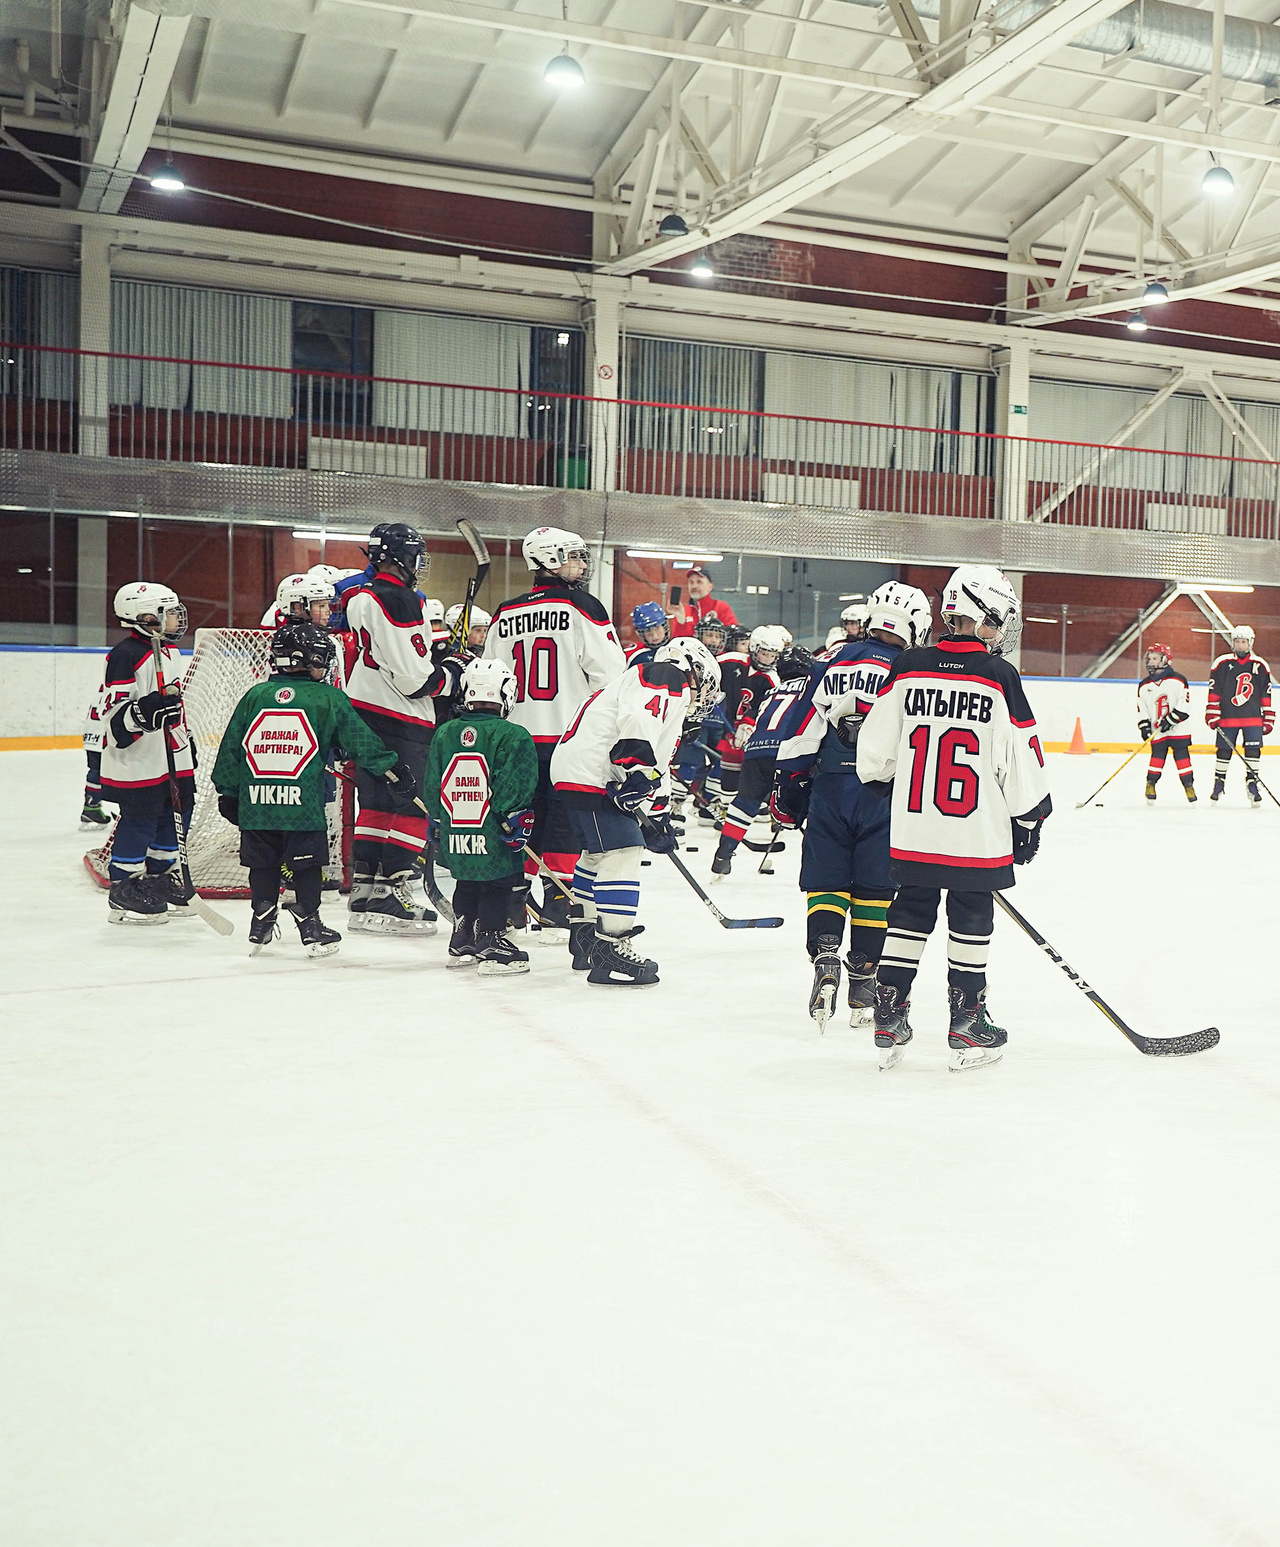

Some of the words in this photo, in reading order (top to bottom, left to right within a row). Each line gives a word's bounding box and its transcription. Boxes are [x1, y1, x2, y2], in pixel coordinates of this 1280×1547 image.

[893, 596, 901, 606] 5
[498, 610, 571, 638] СТЕПАНОВ
[410, 632, 428, 658] 8
[511, 636, 559, 703] 10
[260, 729, 299, 741] УВАЖАЙ
[253, 744, 304, 756] ПАРТНЕРА!
[907, 724, 980, 818] 16
[248, 784, 302, 806] VIKHR
[1038, 941, 1094, 993] CCM
